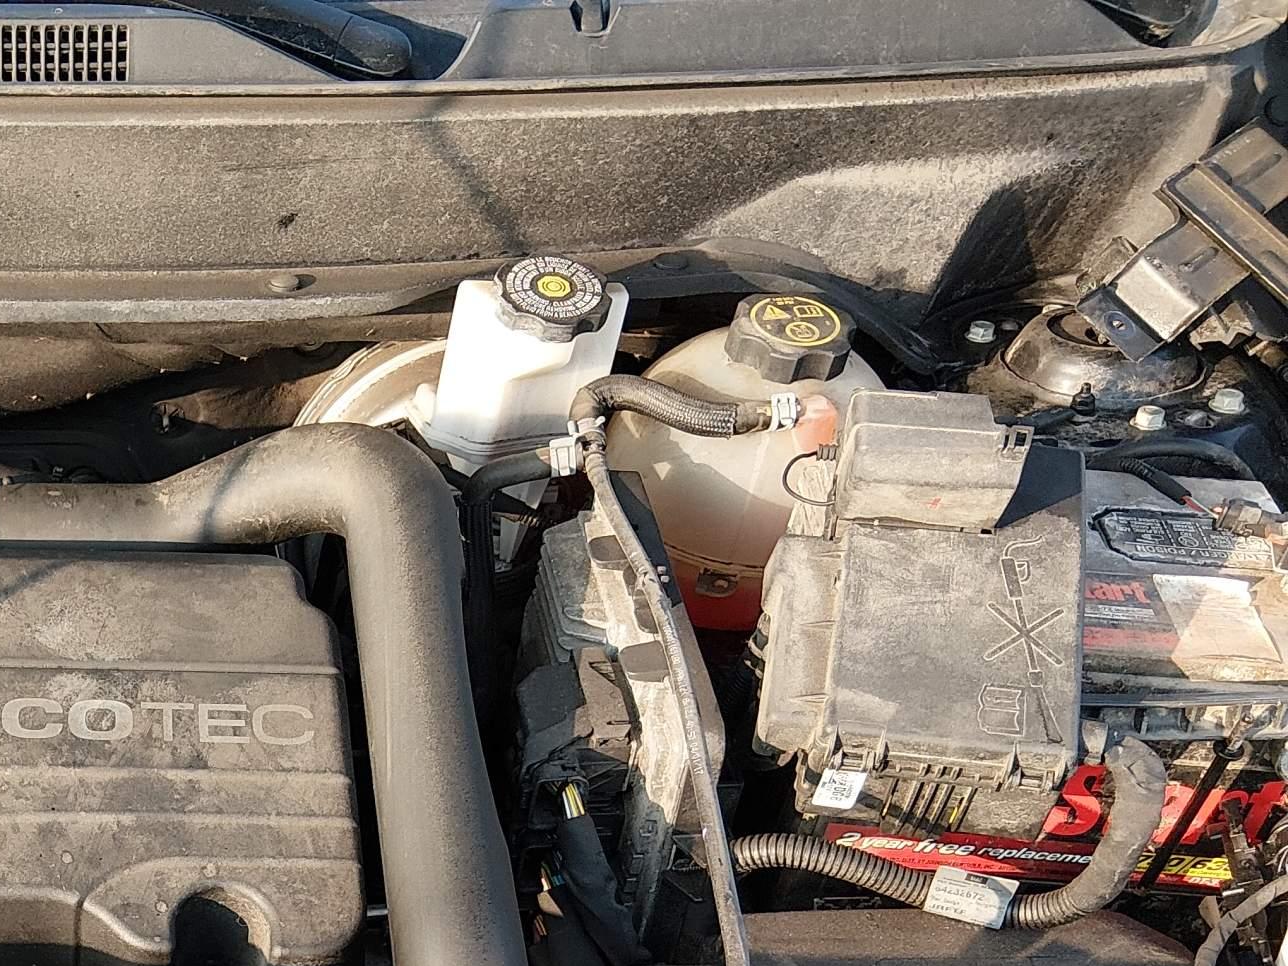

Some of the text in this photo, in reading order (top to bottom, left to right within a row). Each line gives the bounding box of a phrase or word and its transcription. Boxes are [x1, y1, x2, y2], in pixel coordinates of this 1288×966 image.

[836, 831, 863, 848] 2
[860, 835, 914, 851] year
[912, 837, 977, 857] free
